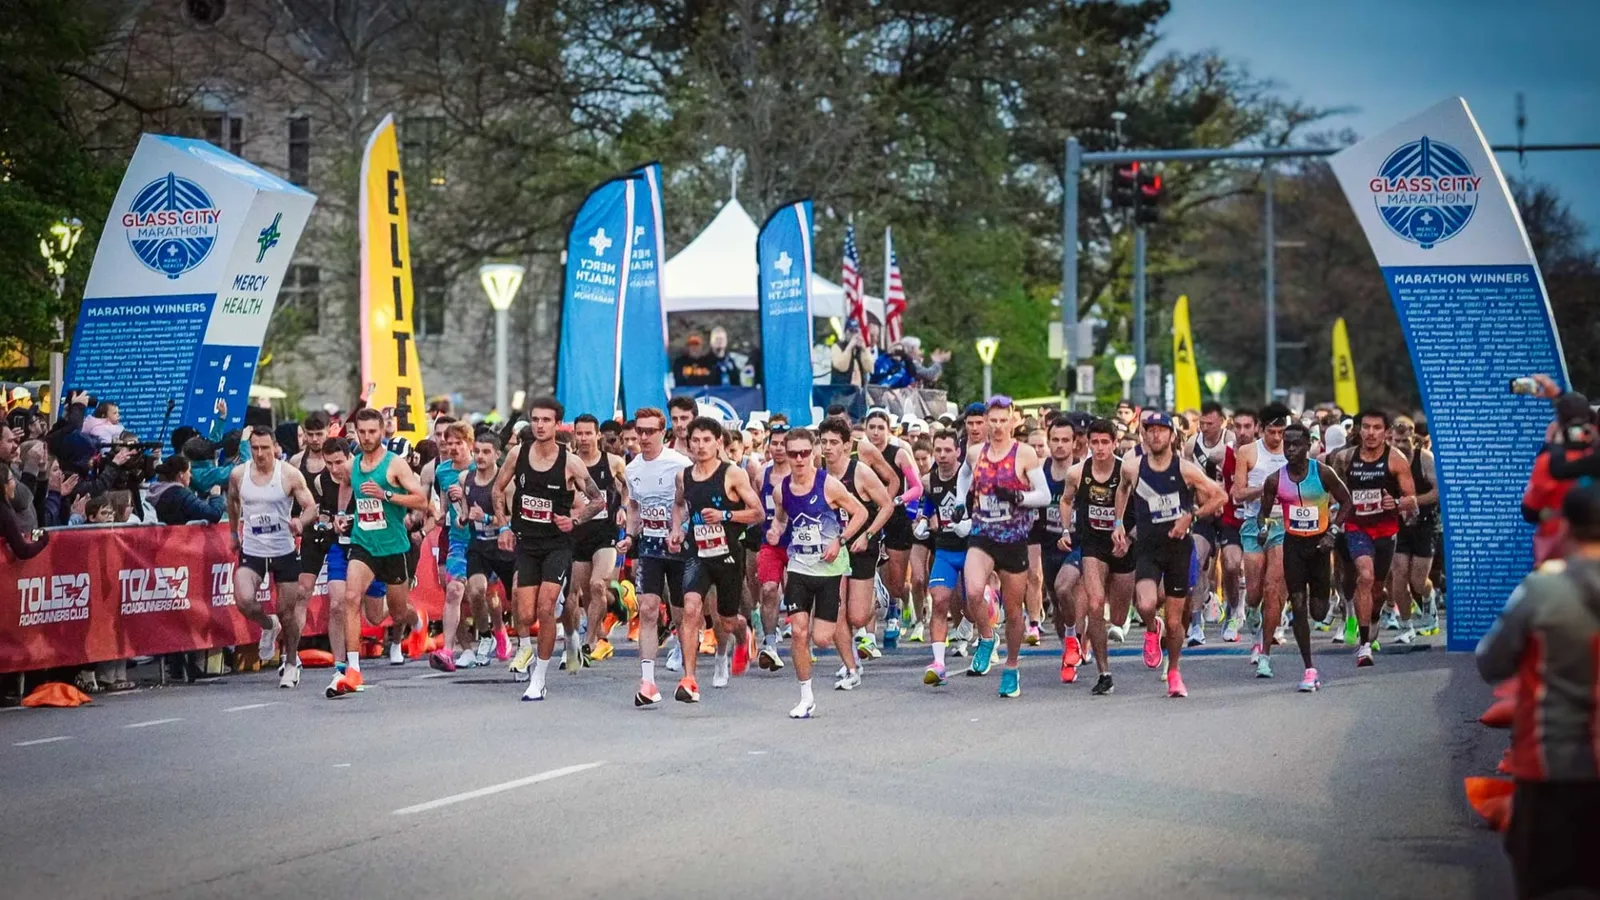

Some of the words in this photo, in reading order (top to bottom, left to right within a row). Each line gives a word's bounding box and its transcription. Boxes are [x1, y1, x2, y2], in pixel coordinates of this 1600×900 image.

[1369, 178, 1431, 194] GLASS
[1438, 176, 1482, 193] CITY
[1387, 192, 1466, 205] MARATHON
[122, 211, 178, 228] GLASS
[181, 209, 223, 225] CITY
[137, 225, 209, 239] MARATHON
[231, 274, 270, 292] MERCY
[1394, 273, 1467, 285] MARATHON
[1470, 272, 1530, 284] WINNERS
[222, 298, 264, 315] HEALTH
[386, 169, 416, 433] ELITE
[87, 303, 151, 317] MARATHON
[153, 301, 207, 315] WINNERS
[358, 499, 380, 510] 2019
[523, 497, 551, 508] 2038
[641, 508, 665, 517] 2004
[1089, 508, 1116, 517] 2044
[1296, 508, 1310, 517] 60
[694, 525, 723, 537] 2040
[798, 532, 812, 542] 66
[118, 566, 190, 604] TOLEDO
[17, 572, 91, 614] TOLEDO
[255, 590, 271, 602] CLUB
[120, 601, 171, 616] ROADRUNNERS
[171, 597, 191, 610] CLUB
[18, 609, 69, 627] ROADRUNNERS
[69, 606, 90, 622] CLUB
